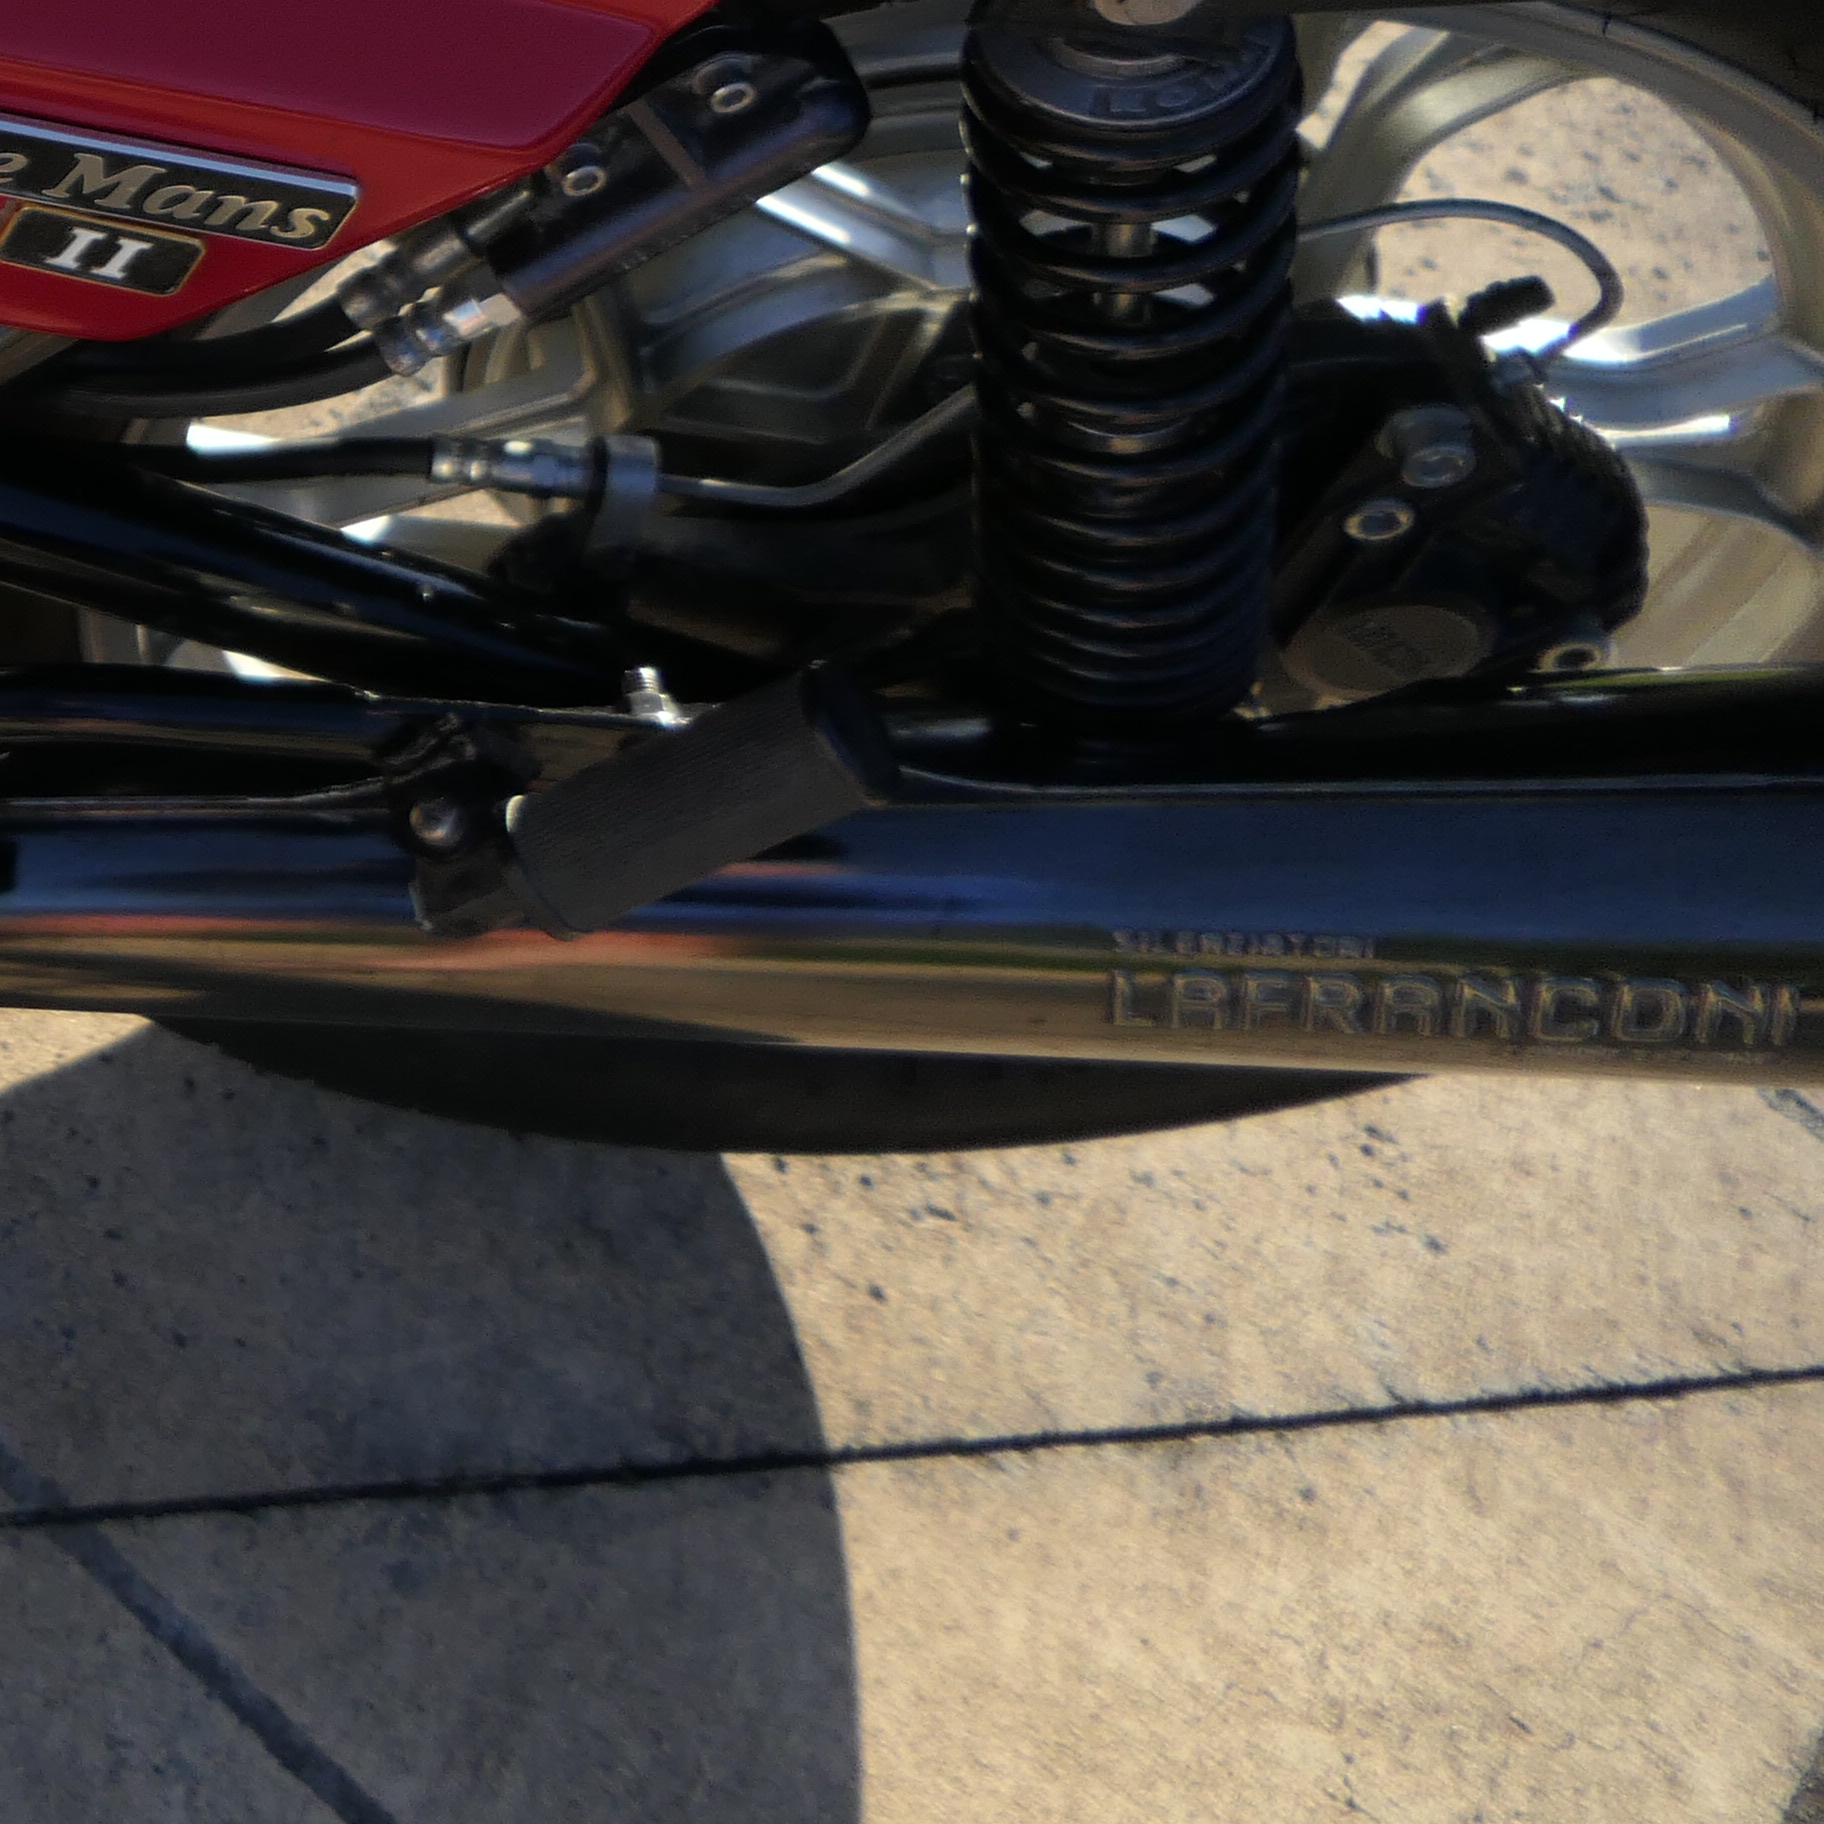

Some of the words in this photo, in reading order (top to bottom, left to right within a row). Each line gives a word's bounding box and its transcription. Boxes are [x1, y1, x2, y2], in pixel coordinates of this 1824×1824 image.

[42, 152, 332, 240] Mans
[46, 228, 152, 280] II
[1110, 968, 1798, 1046] LAFRANCONI
